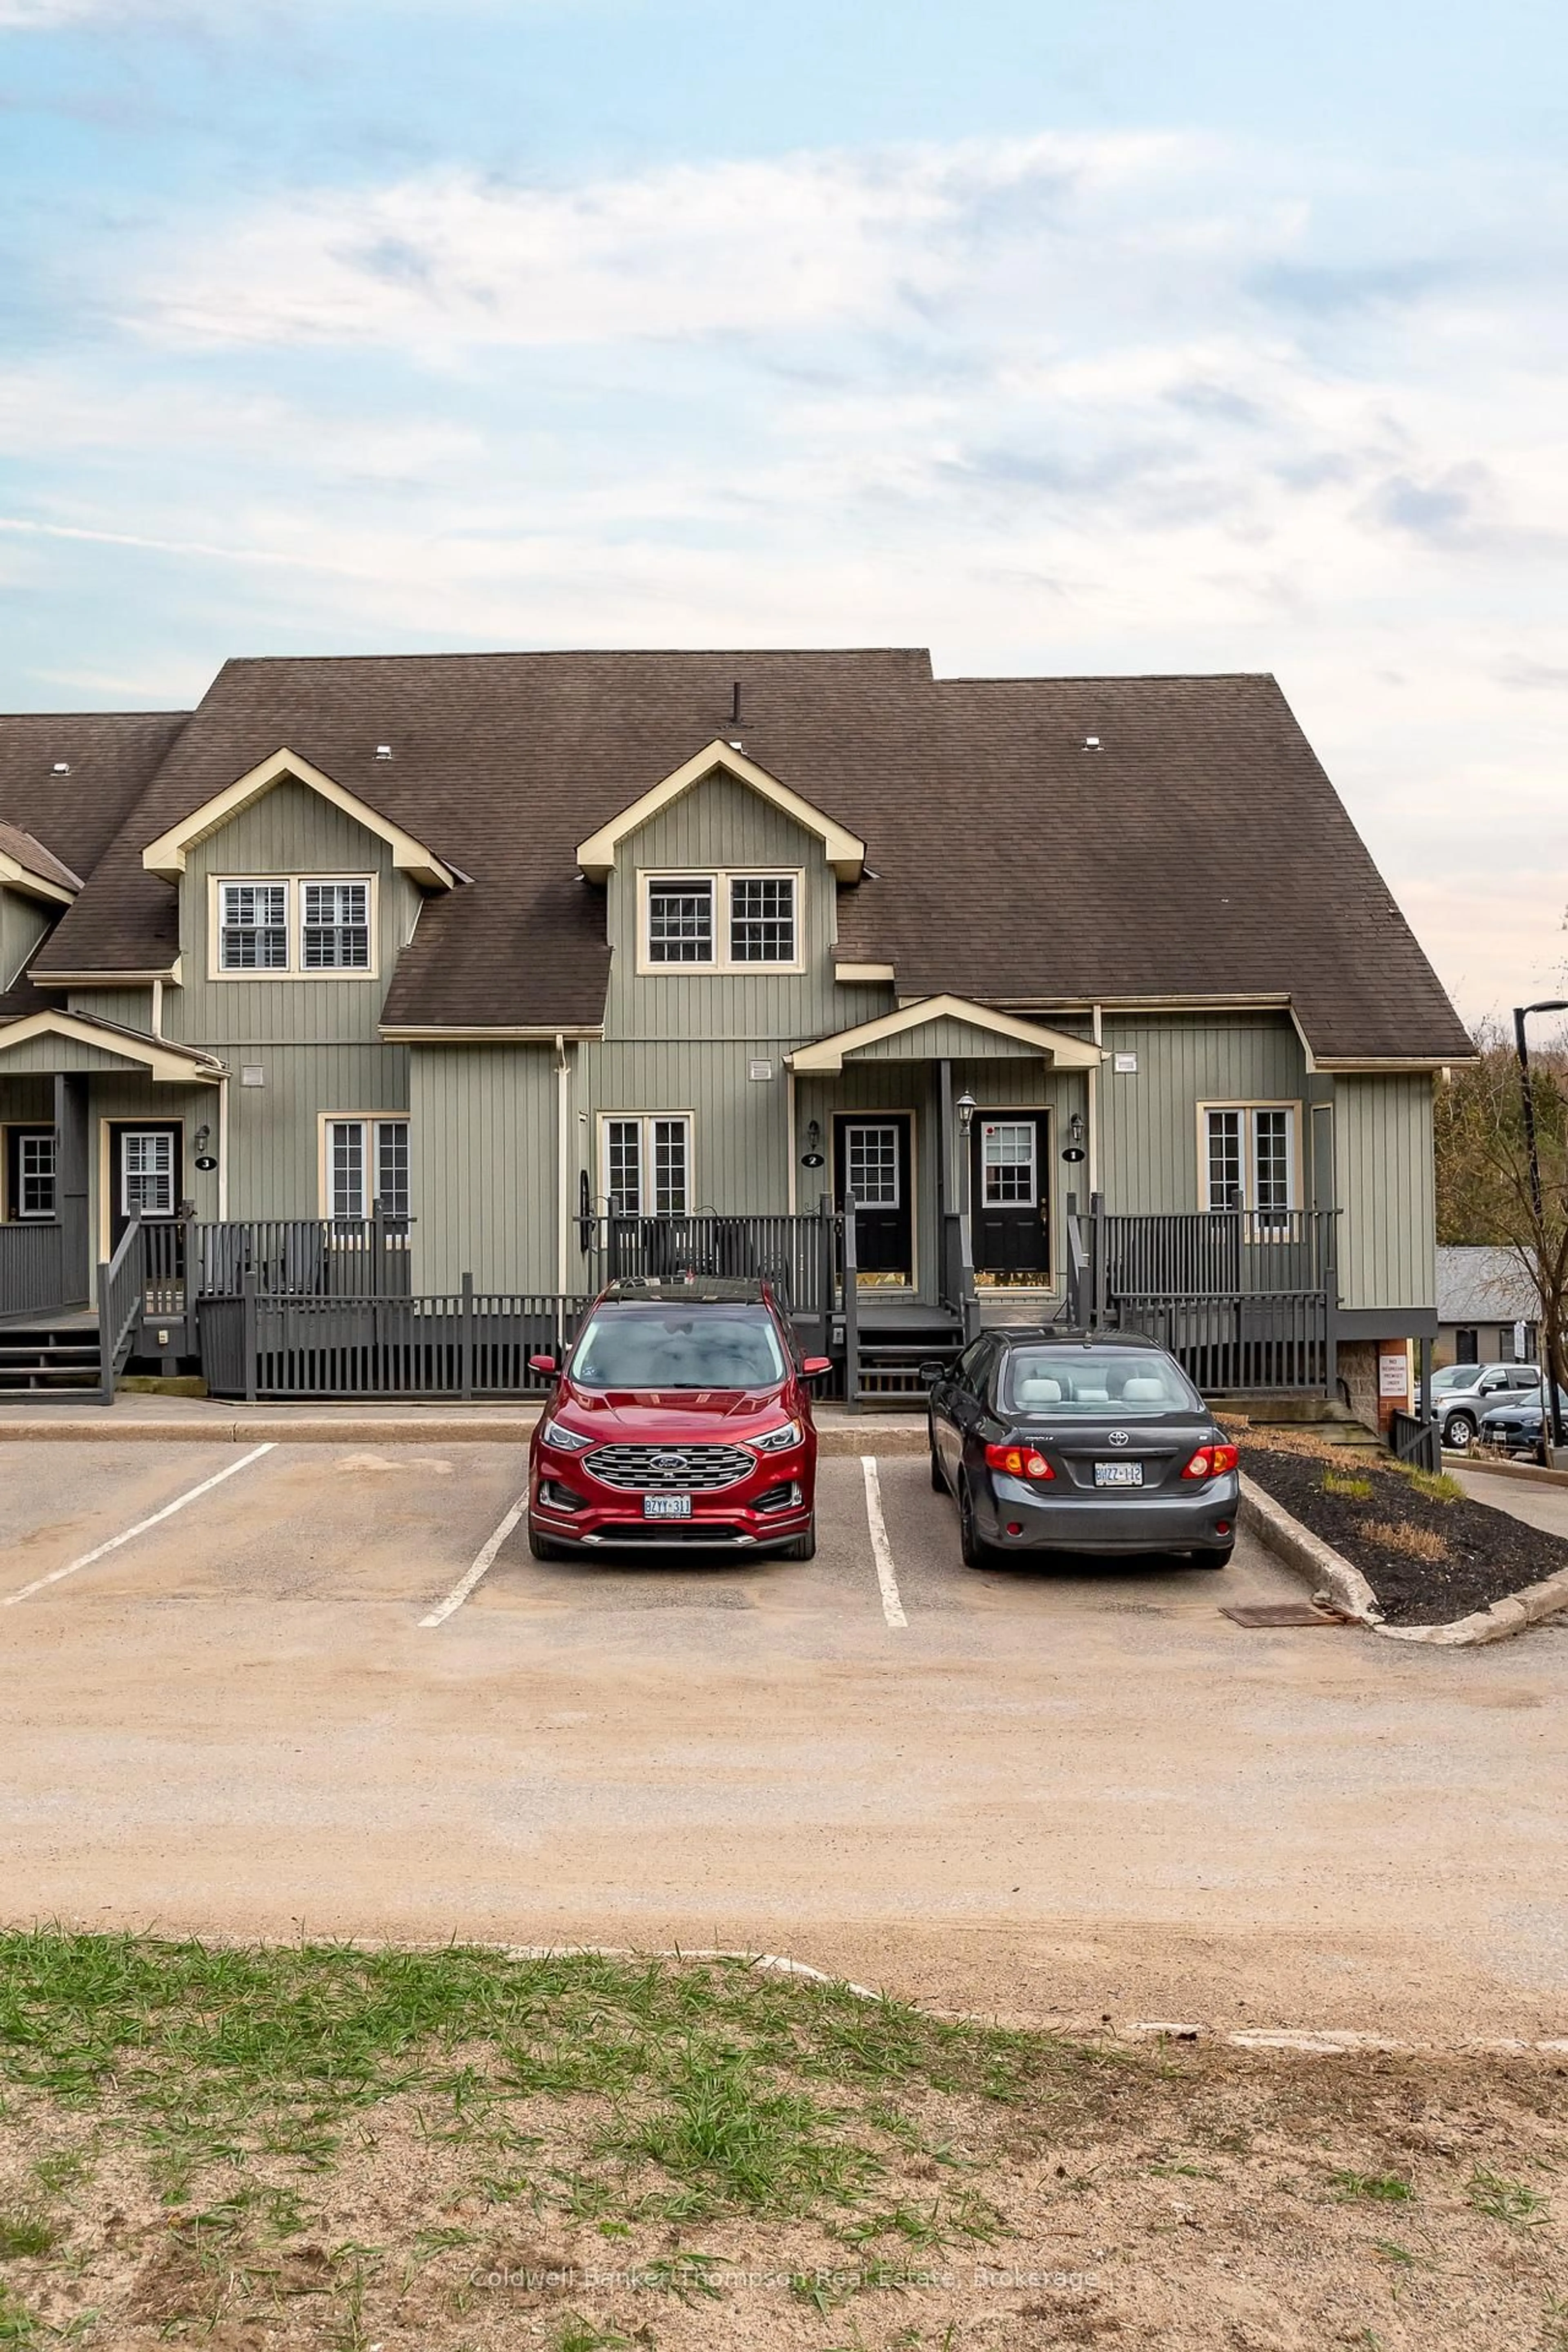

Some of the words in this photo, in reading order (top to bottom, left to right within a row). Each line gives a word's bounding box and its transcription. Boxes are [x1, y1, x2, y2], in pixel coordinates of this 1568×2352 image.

[202, 1159, 209, 1168] 3
[809, 1156, 816, 1165] 2
[659, 1458, 678, 1467] Ford
